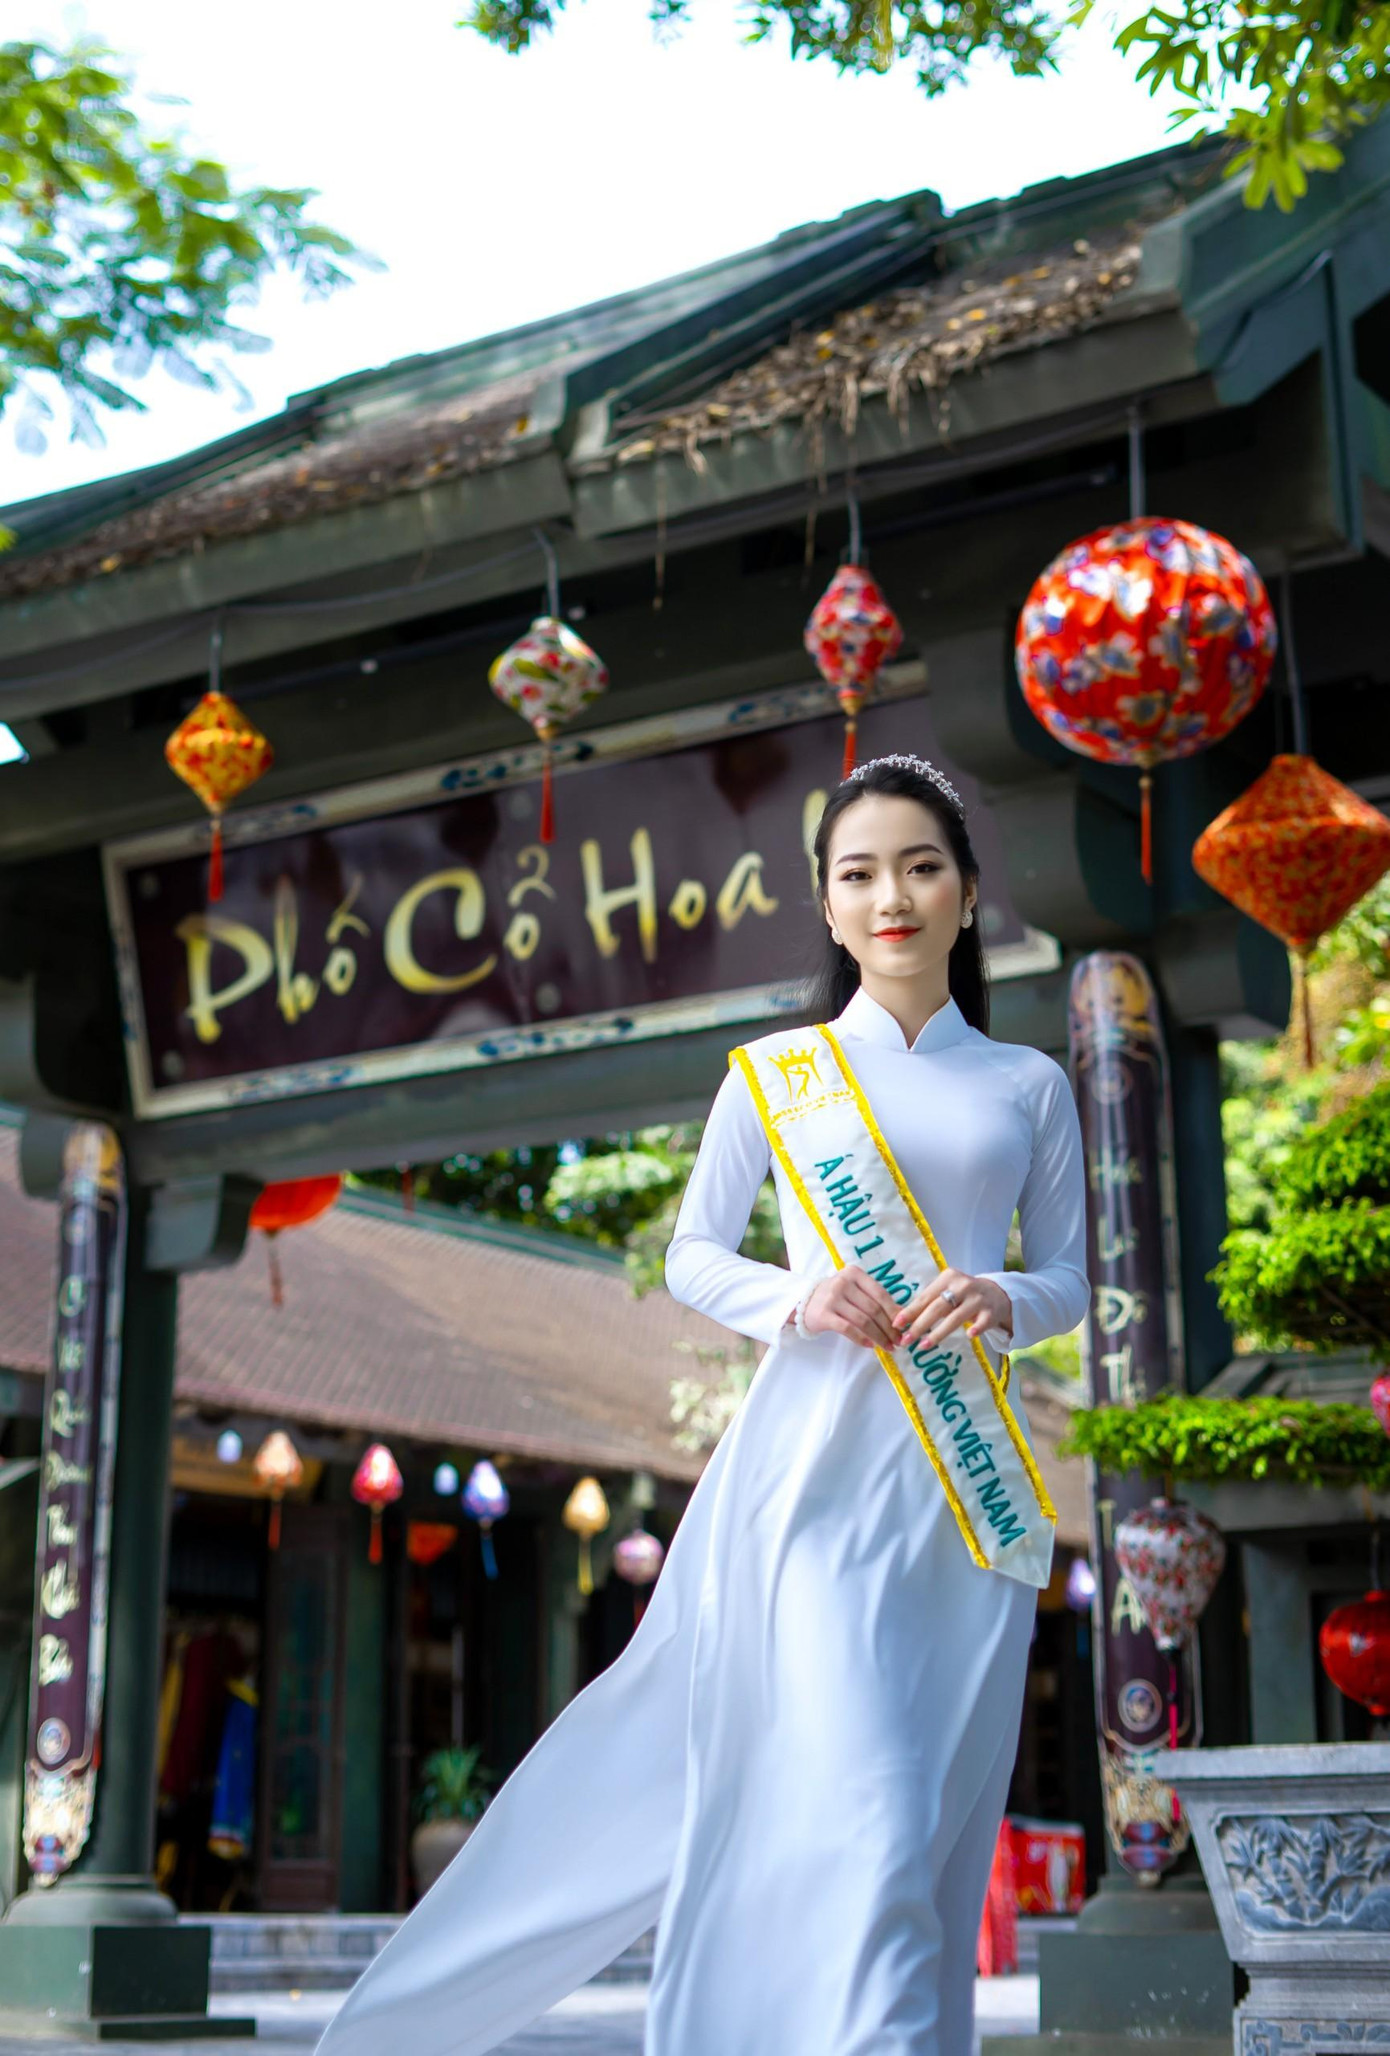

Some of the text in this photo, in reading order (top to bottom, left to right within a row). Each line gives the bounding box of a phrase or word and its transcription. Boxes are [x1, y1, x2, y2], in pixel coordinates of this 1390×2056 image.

[175, 872, 371, 1043] Phố
[384, 844, 556, 993] Cổ
[580, 826, 778, 964] Hoa
[814, 1153, 1027, 1547] Á HẬU 1 MÔ ƯỜNG VIỆT NAM
